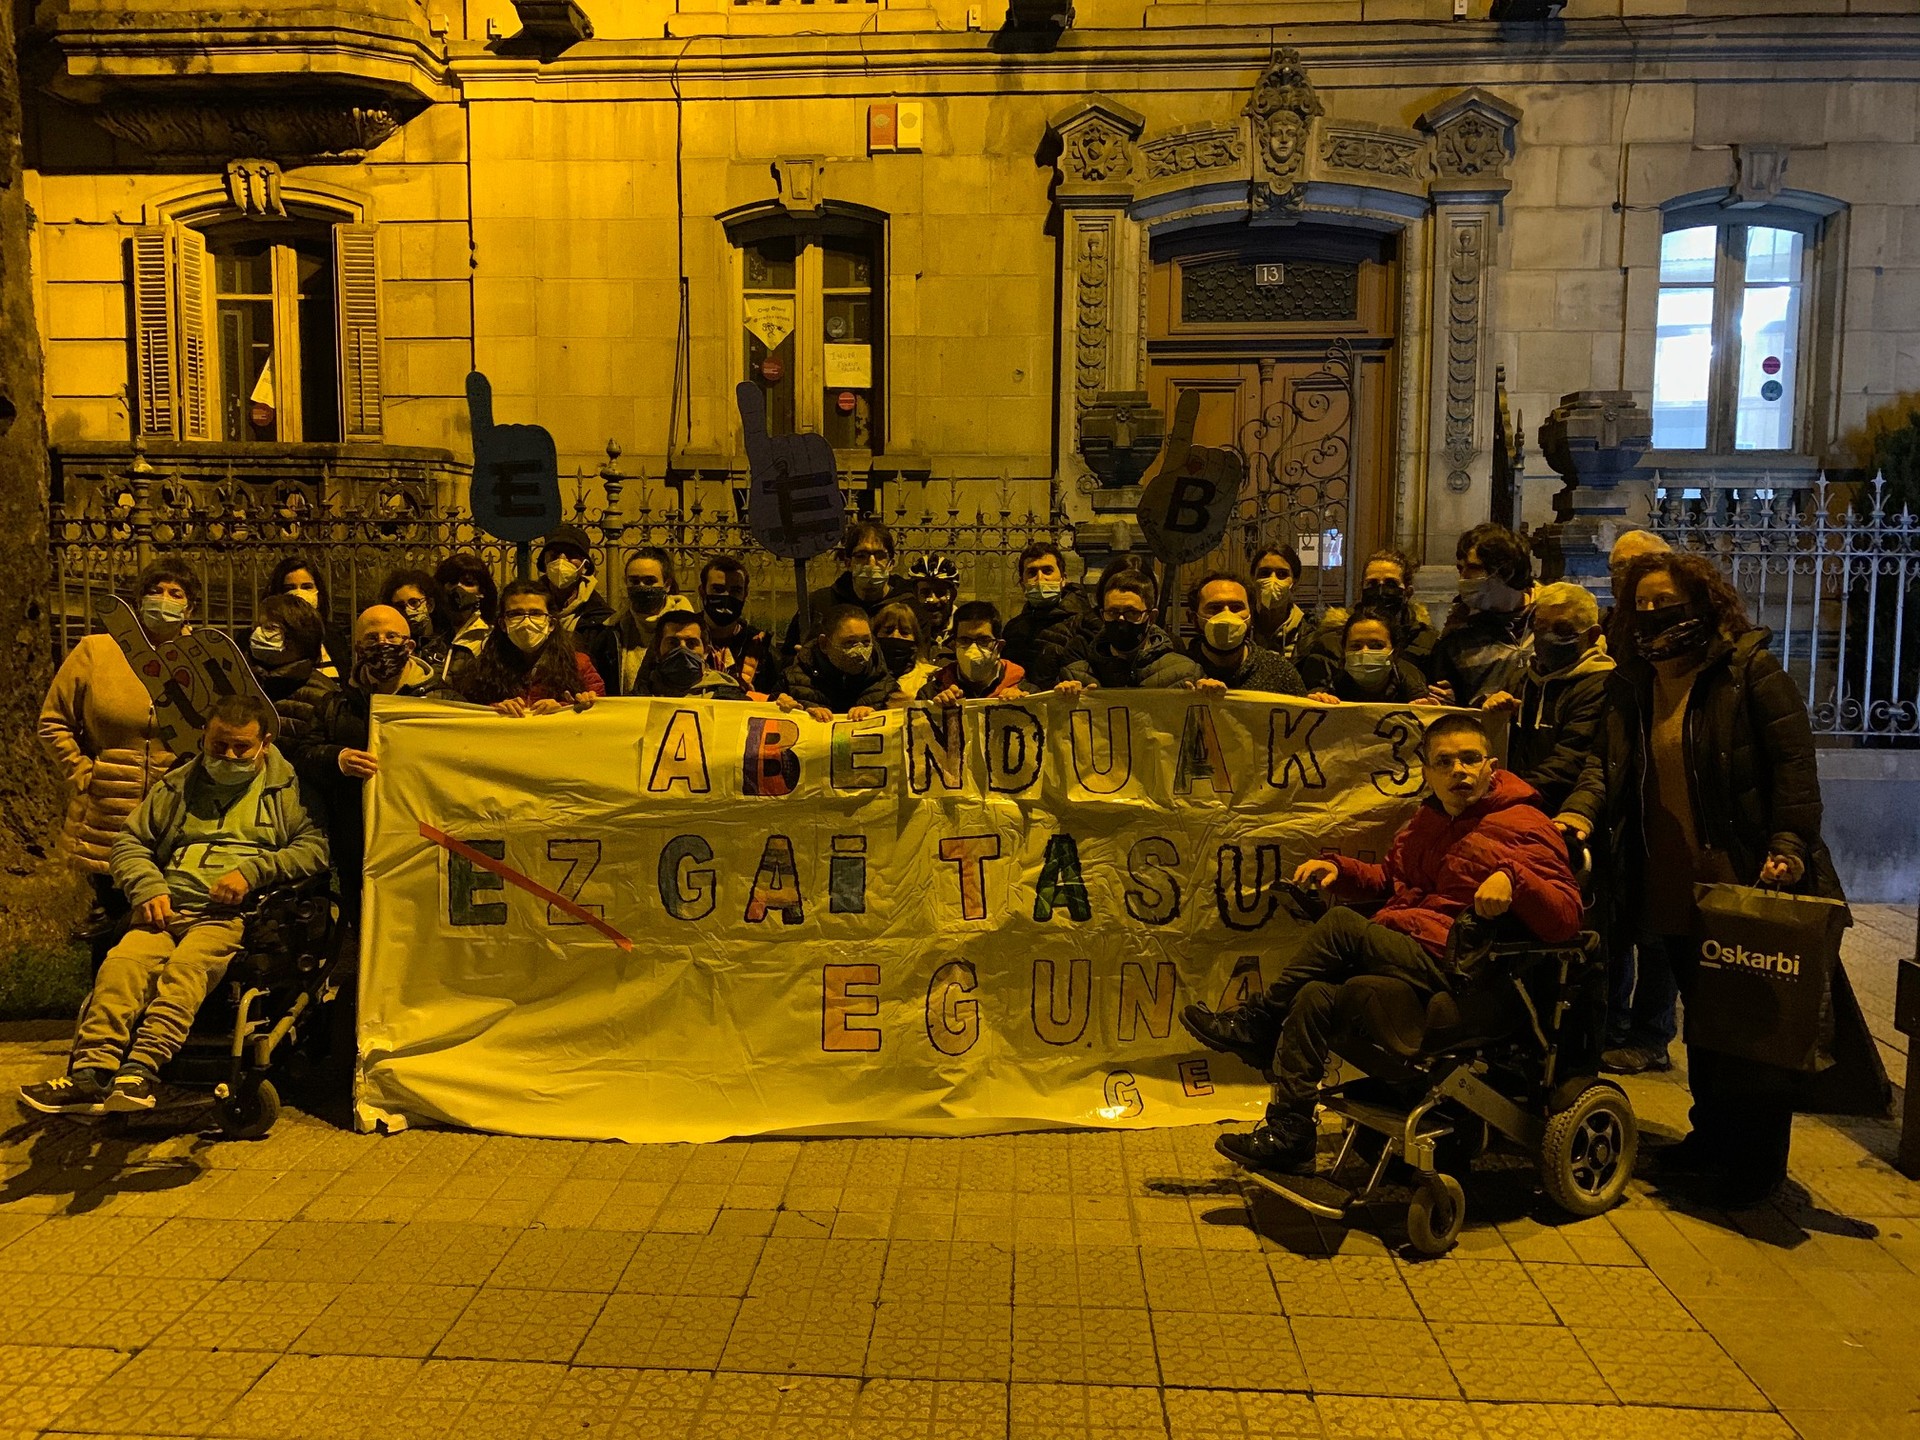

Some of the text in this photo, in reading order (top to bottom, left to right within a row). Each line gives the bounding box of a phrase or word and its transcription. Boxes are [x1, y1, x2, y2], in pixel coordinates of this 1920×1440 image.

[1262, 266, 1279, 282] 13
[489, 460, 546, 517] E
[762, 471, 840, 544] E
[1166, 477, 1217, 533] B
[647, 704, 1425, 797] ABENDUAK 3
[1701, 940, 1801, 976] Oskarbi
[822, 956, 1267, 1057] EGUNA
